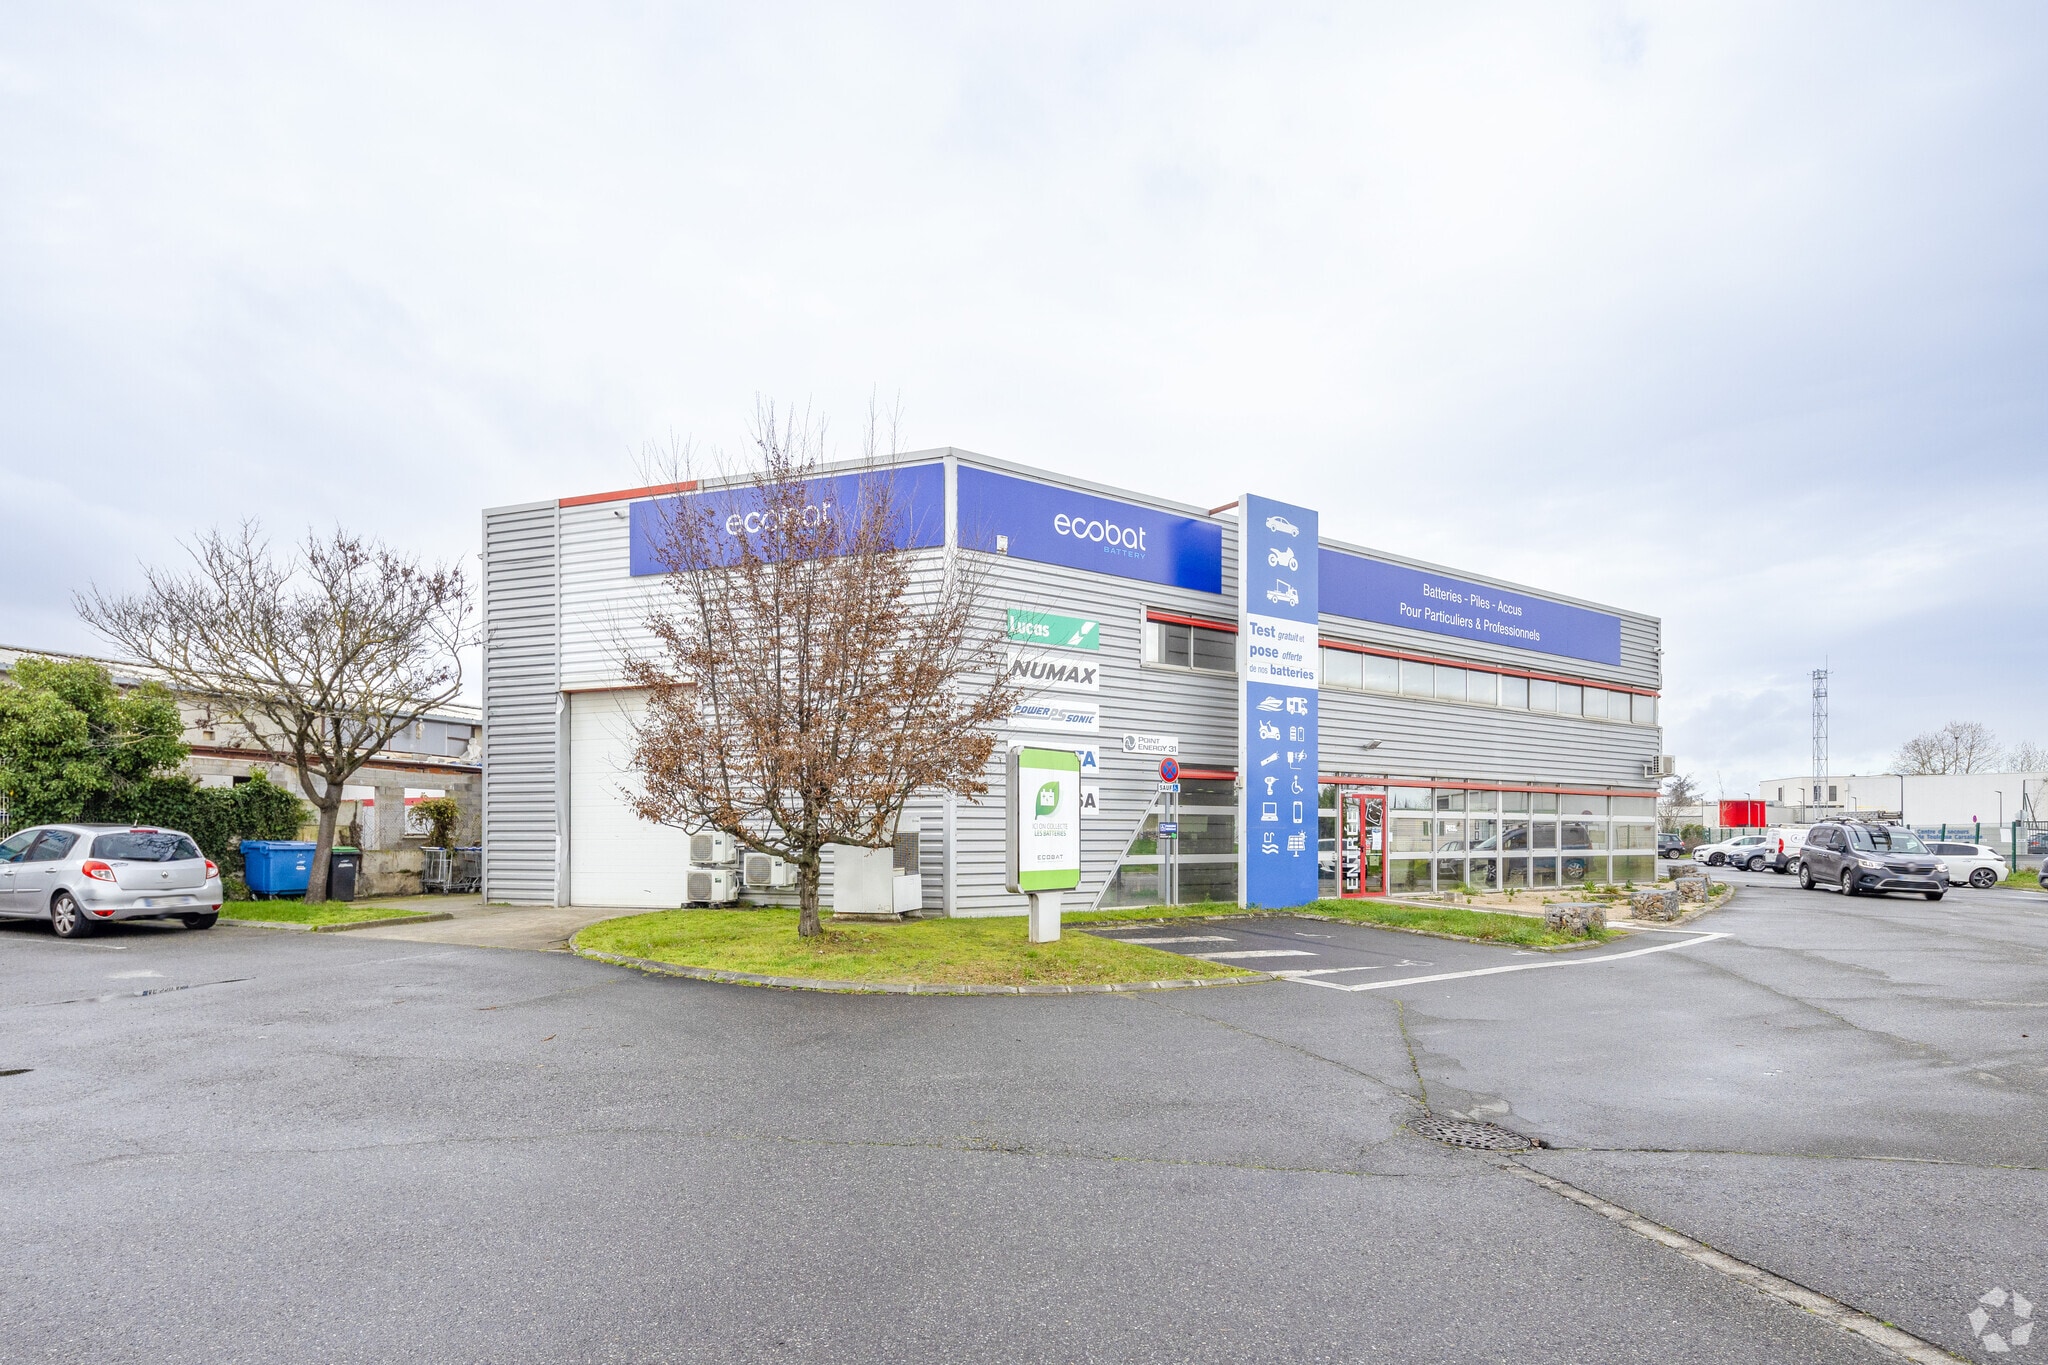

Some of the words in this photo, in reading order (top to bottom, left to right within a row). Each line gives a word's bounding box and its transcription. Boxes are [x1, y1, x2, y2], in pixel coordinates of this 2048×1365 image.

[1053, 513, 1147, 551] ecobat
[1103, 546, 1146, 560] BATTERY
[1423, 583, 1462, 604] Batteries
[1470, 594, 1490, 610] Piles
[1497, 601, 1523, 616] Accus
[1009, 615, 1050, 638] Lucas
[1249, 621, 1276, 638] Test
[1277, 631, 1299, 643] gratuit
[1299, 635, 1305, 643] et
[1400, 602, 1422, 619] Pour
[1424, 607, 1473, 628] Particuliers
[1475, 617, 1481, 630] &
[1484, 619, 1541, 641] Professionnels
[1249, 645, 1279, 658] pose
[1282, 651, 1303, 662] offerte
[1011, 659, 1097, 685] NUMAX
[1249, 664, 1256, 673] de
[1257, 666, 1268, 674] nos
[1270, 663, 1314, 680] batteries
[1013, 705, 1051, 716] POWER
[1065, 714, 1095, 724] SONIC
